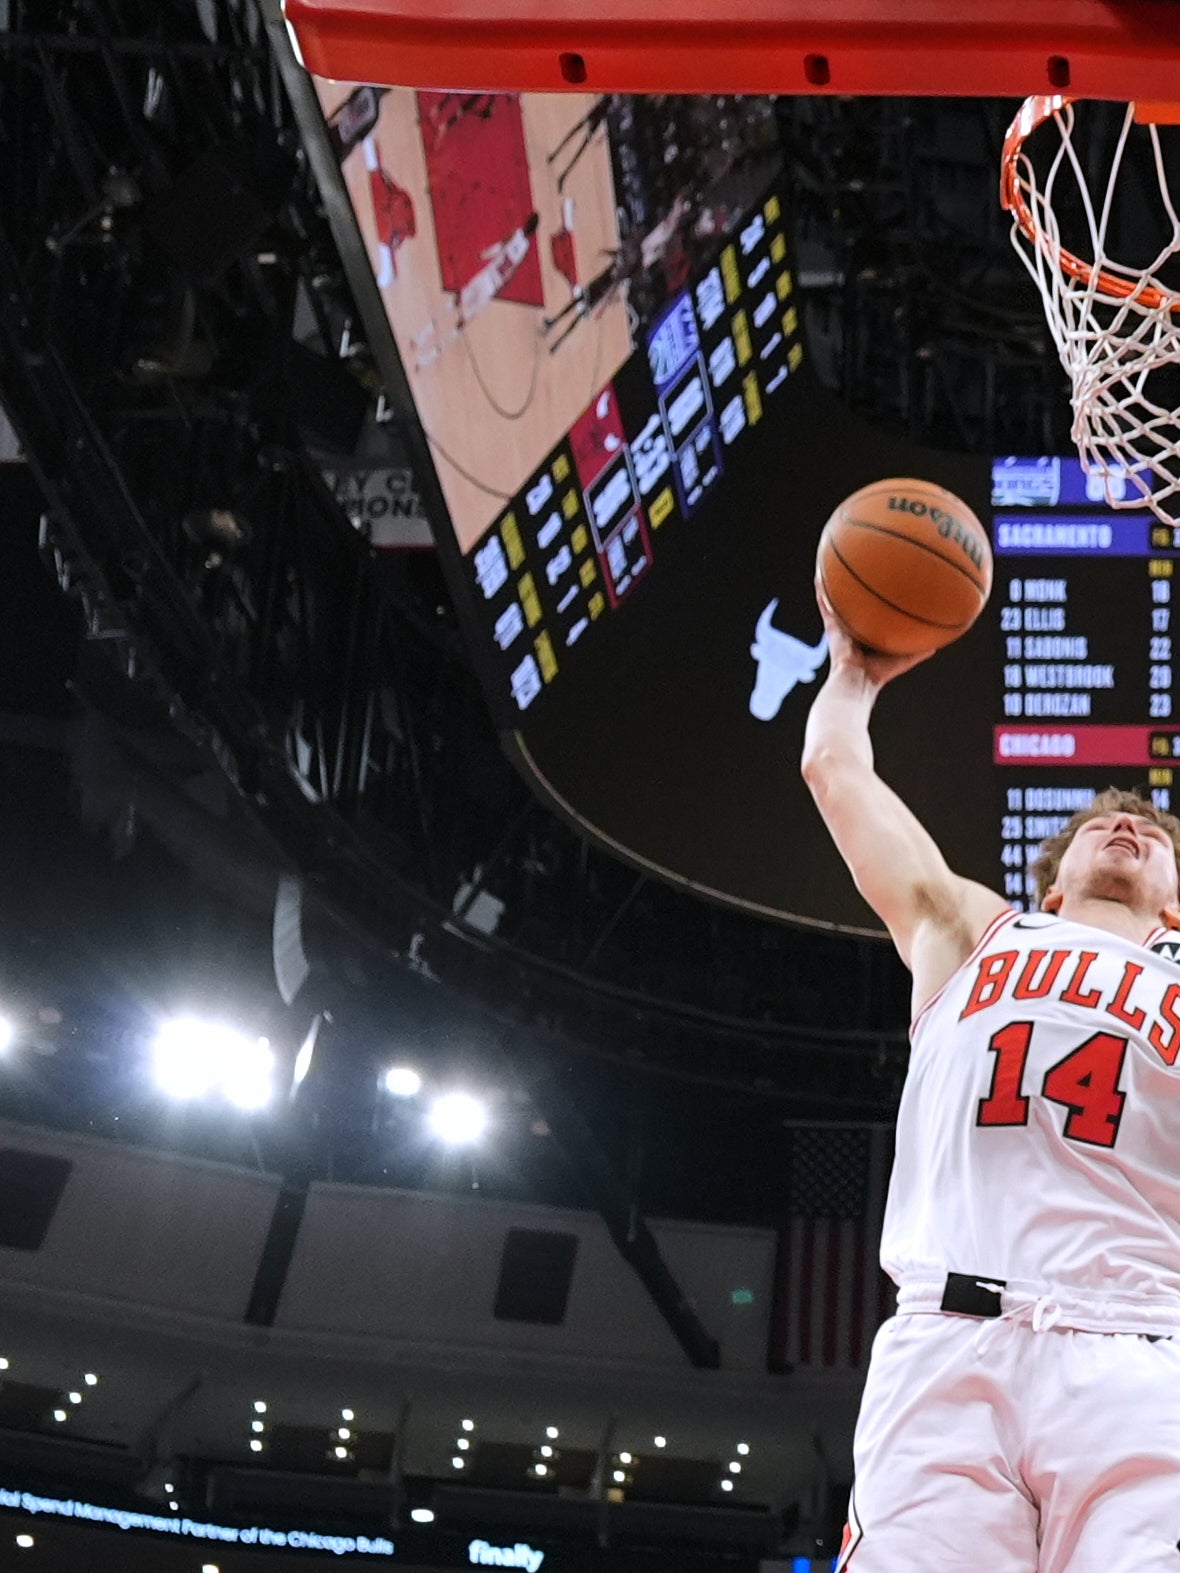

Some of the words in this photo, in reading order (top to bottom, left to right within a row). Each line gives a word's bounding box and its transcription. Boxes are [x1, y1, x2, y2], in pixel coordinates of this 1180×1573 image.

[999, 524, 1111, 548] SACRAMENTO
[1024, 579, 1066, 602] MONK
[1001, 608, 1022, 630] 23
[1024, 608, 1065, 630] ELLIS
[1024, 636, 1087, 659] SABONIS
[1150, 637, 1171, 660] 22
[1025, 665, 1114, 688] WESTBROOK
[1025, 693, 1090, 716] DEROZAN
[1000, 735, 1074, 754] CHICAGO
[976, 1021, 1129, 1148] 14
[21, 1493, 73, 1516] Spend
[74, 1501, 182, 1532] Management
[287, 1531, 356, 1555] Chicago
[356, 1536, 394, 1555] Bulls
[469, 1540, 544, 1573] finally
